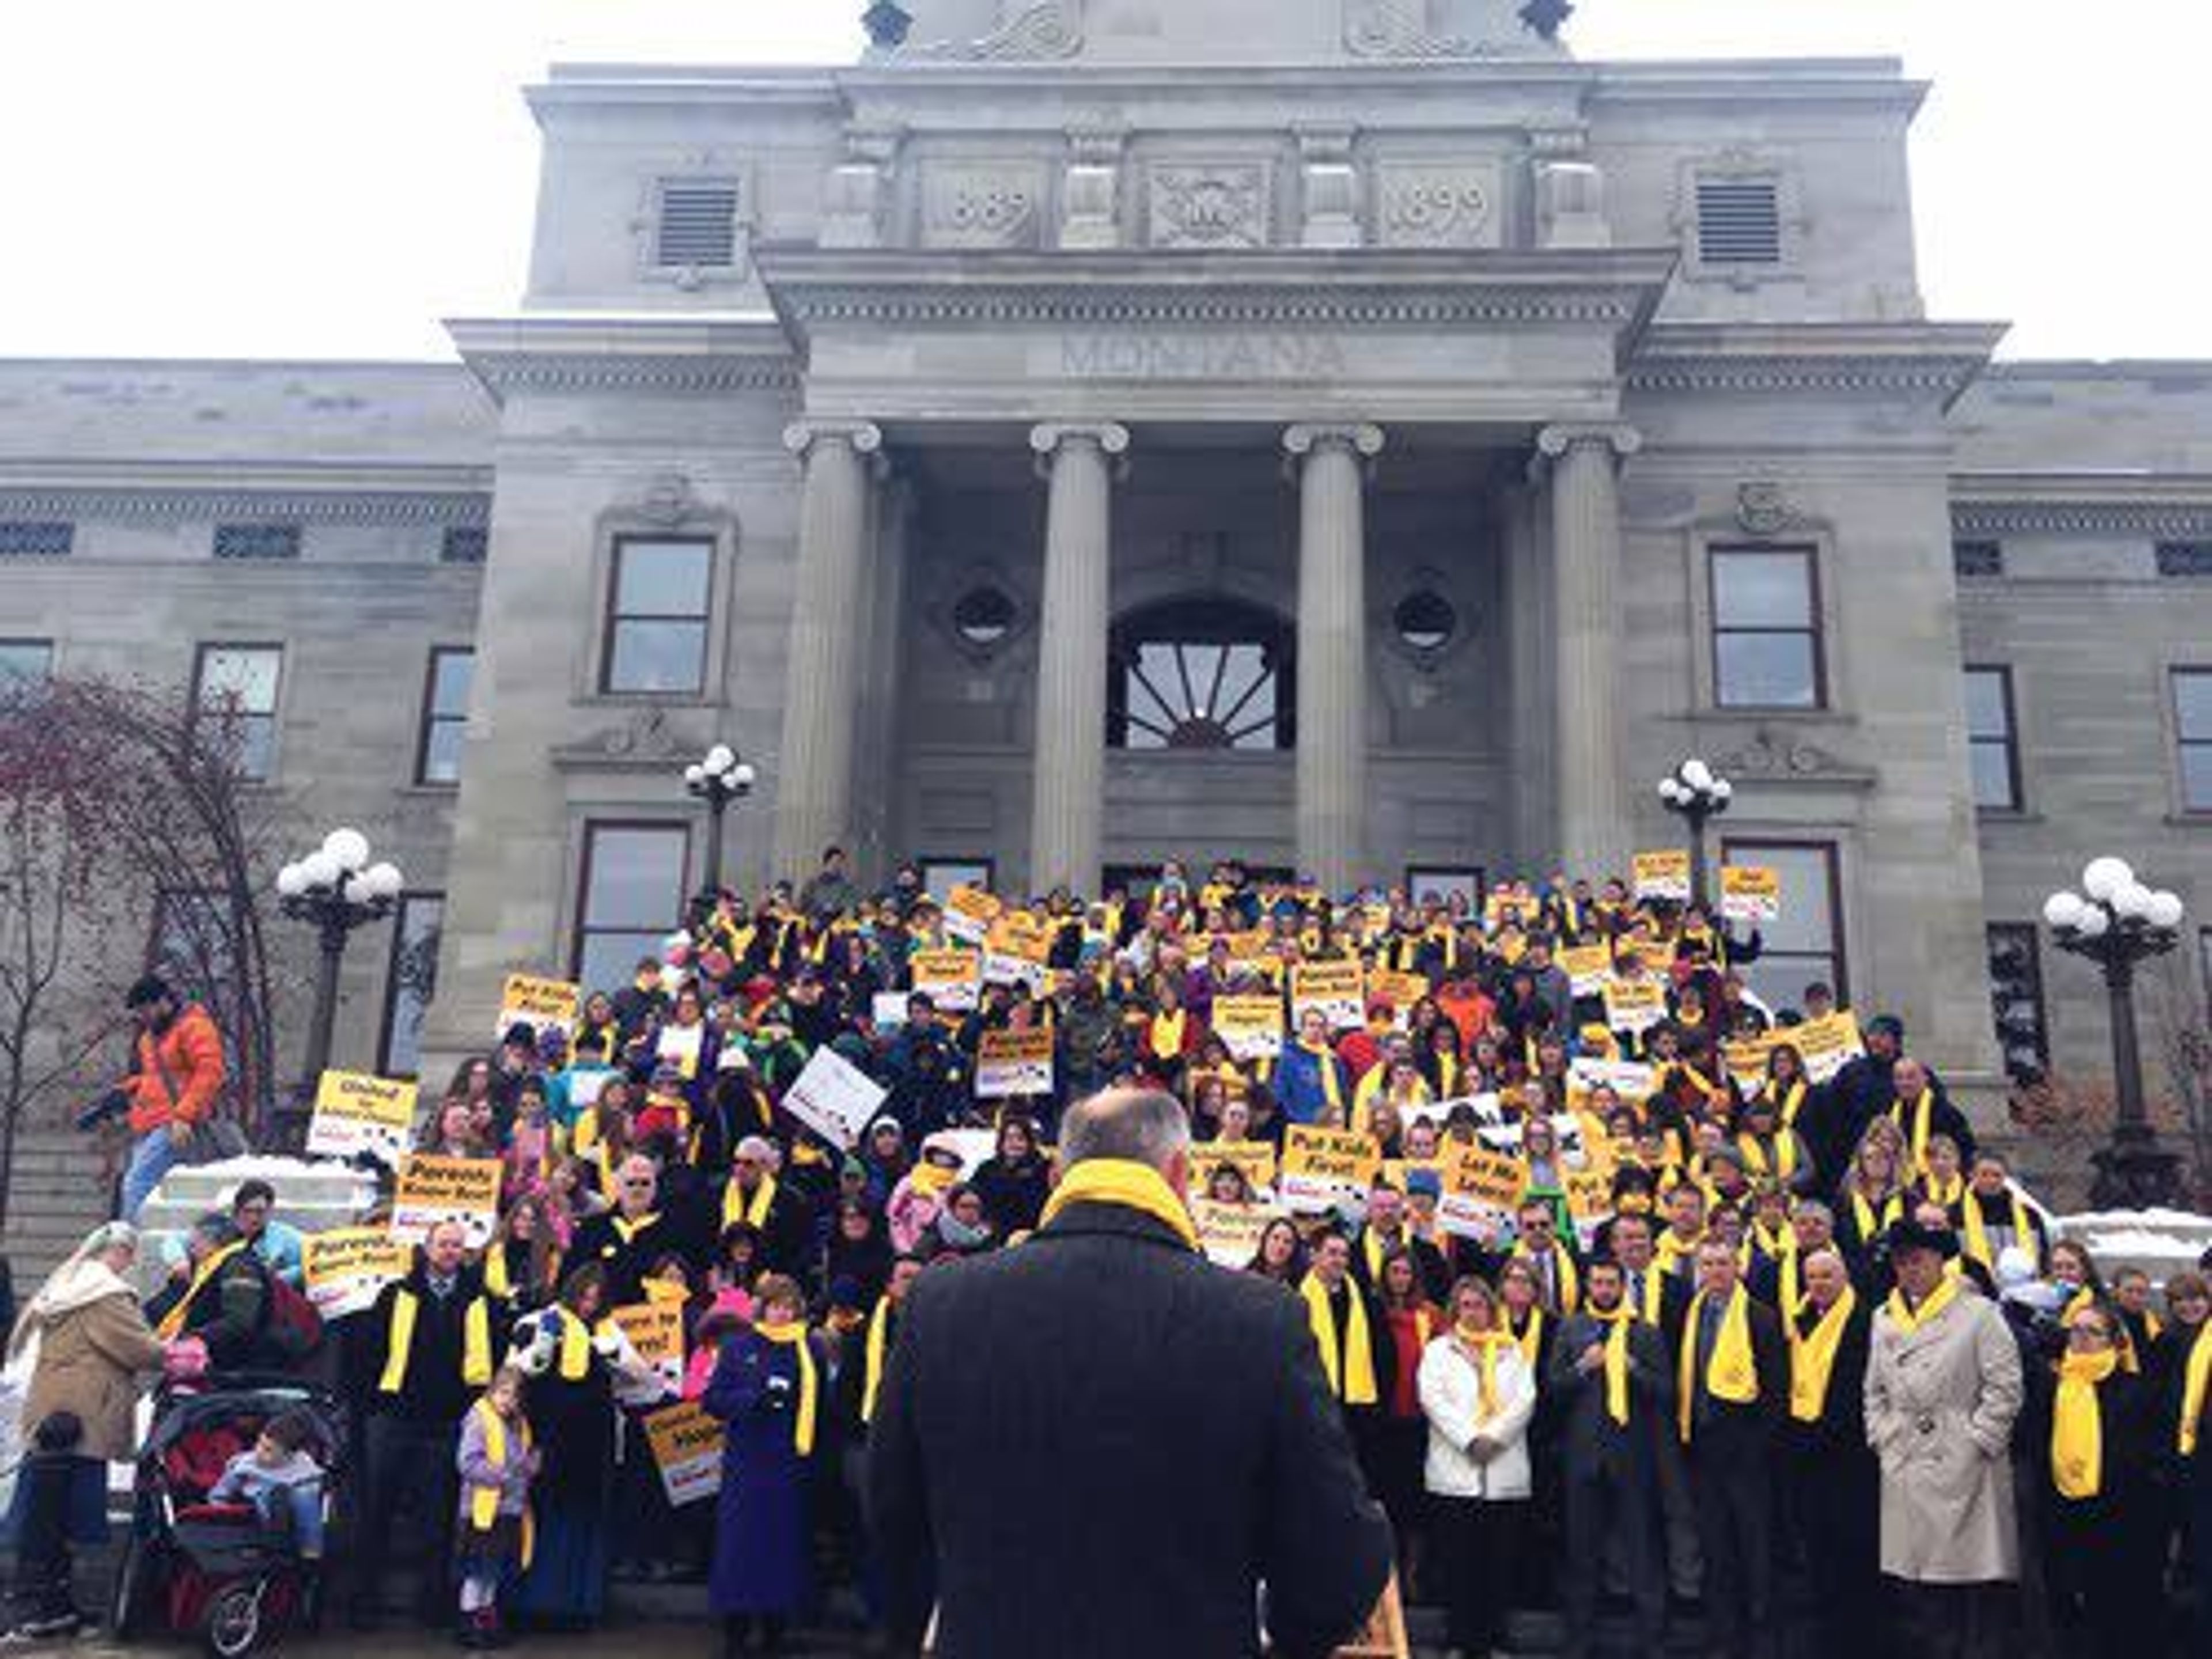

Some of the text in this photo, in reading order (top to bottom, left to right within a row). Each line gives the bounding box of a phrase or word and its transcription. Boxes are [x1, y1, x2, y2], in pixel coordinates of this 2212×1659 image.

[1061, 334, 1344, 373] MONTANA
[410, 1160, 492, 1184] Parents
[403, 1181, 451, 1197] Know
[311, 1236, 395, 1258] Parents
